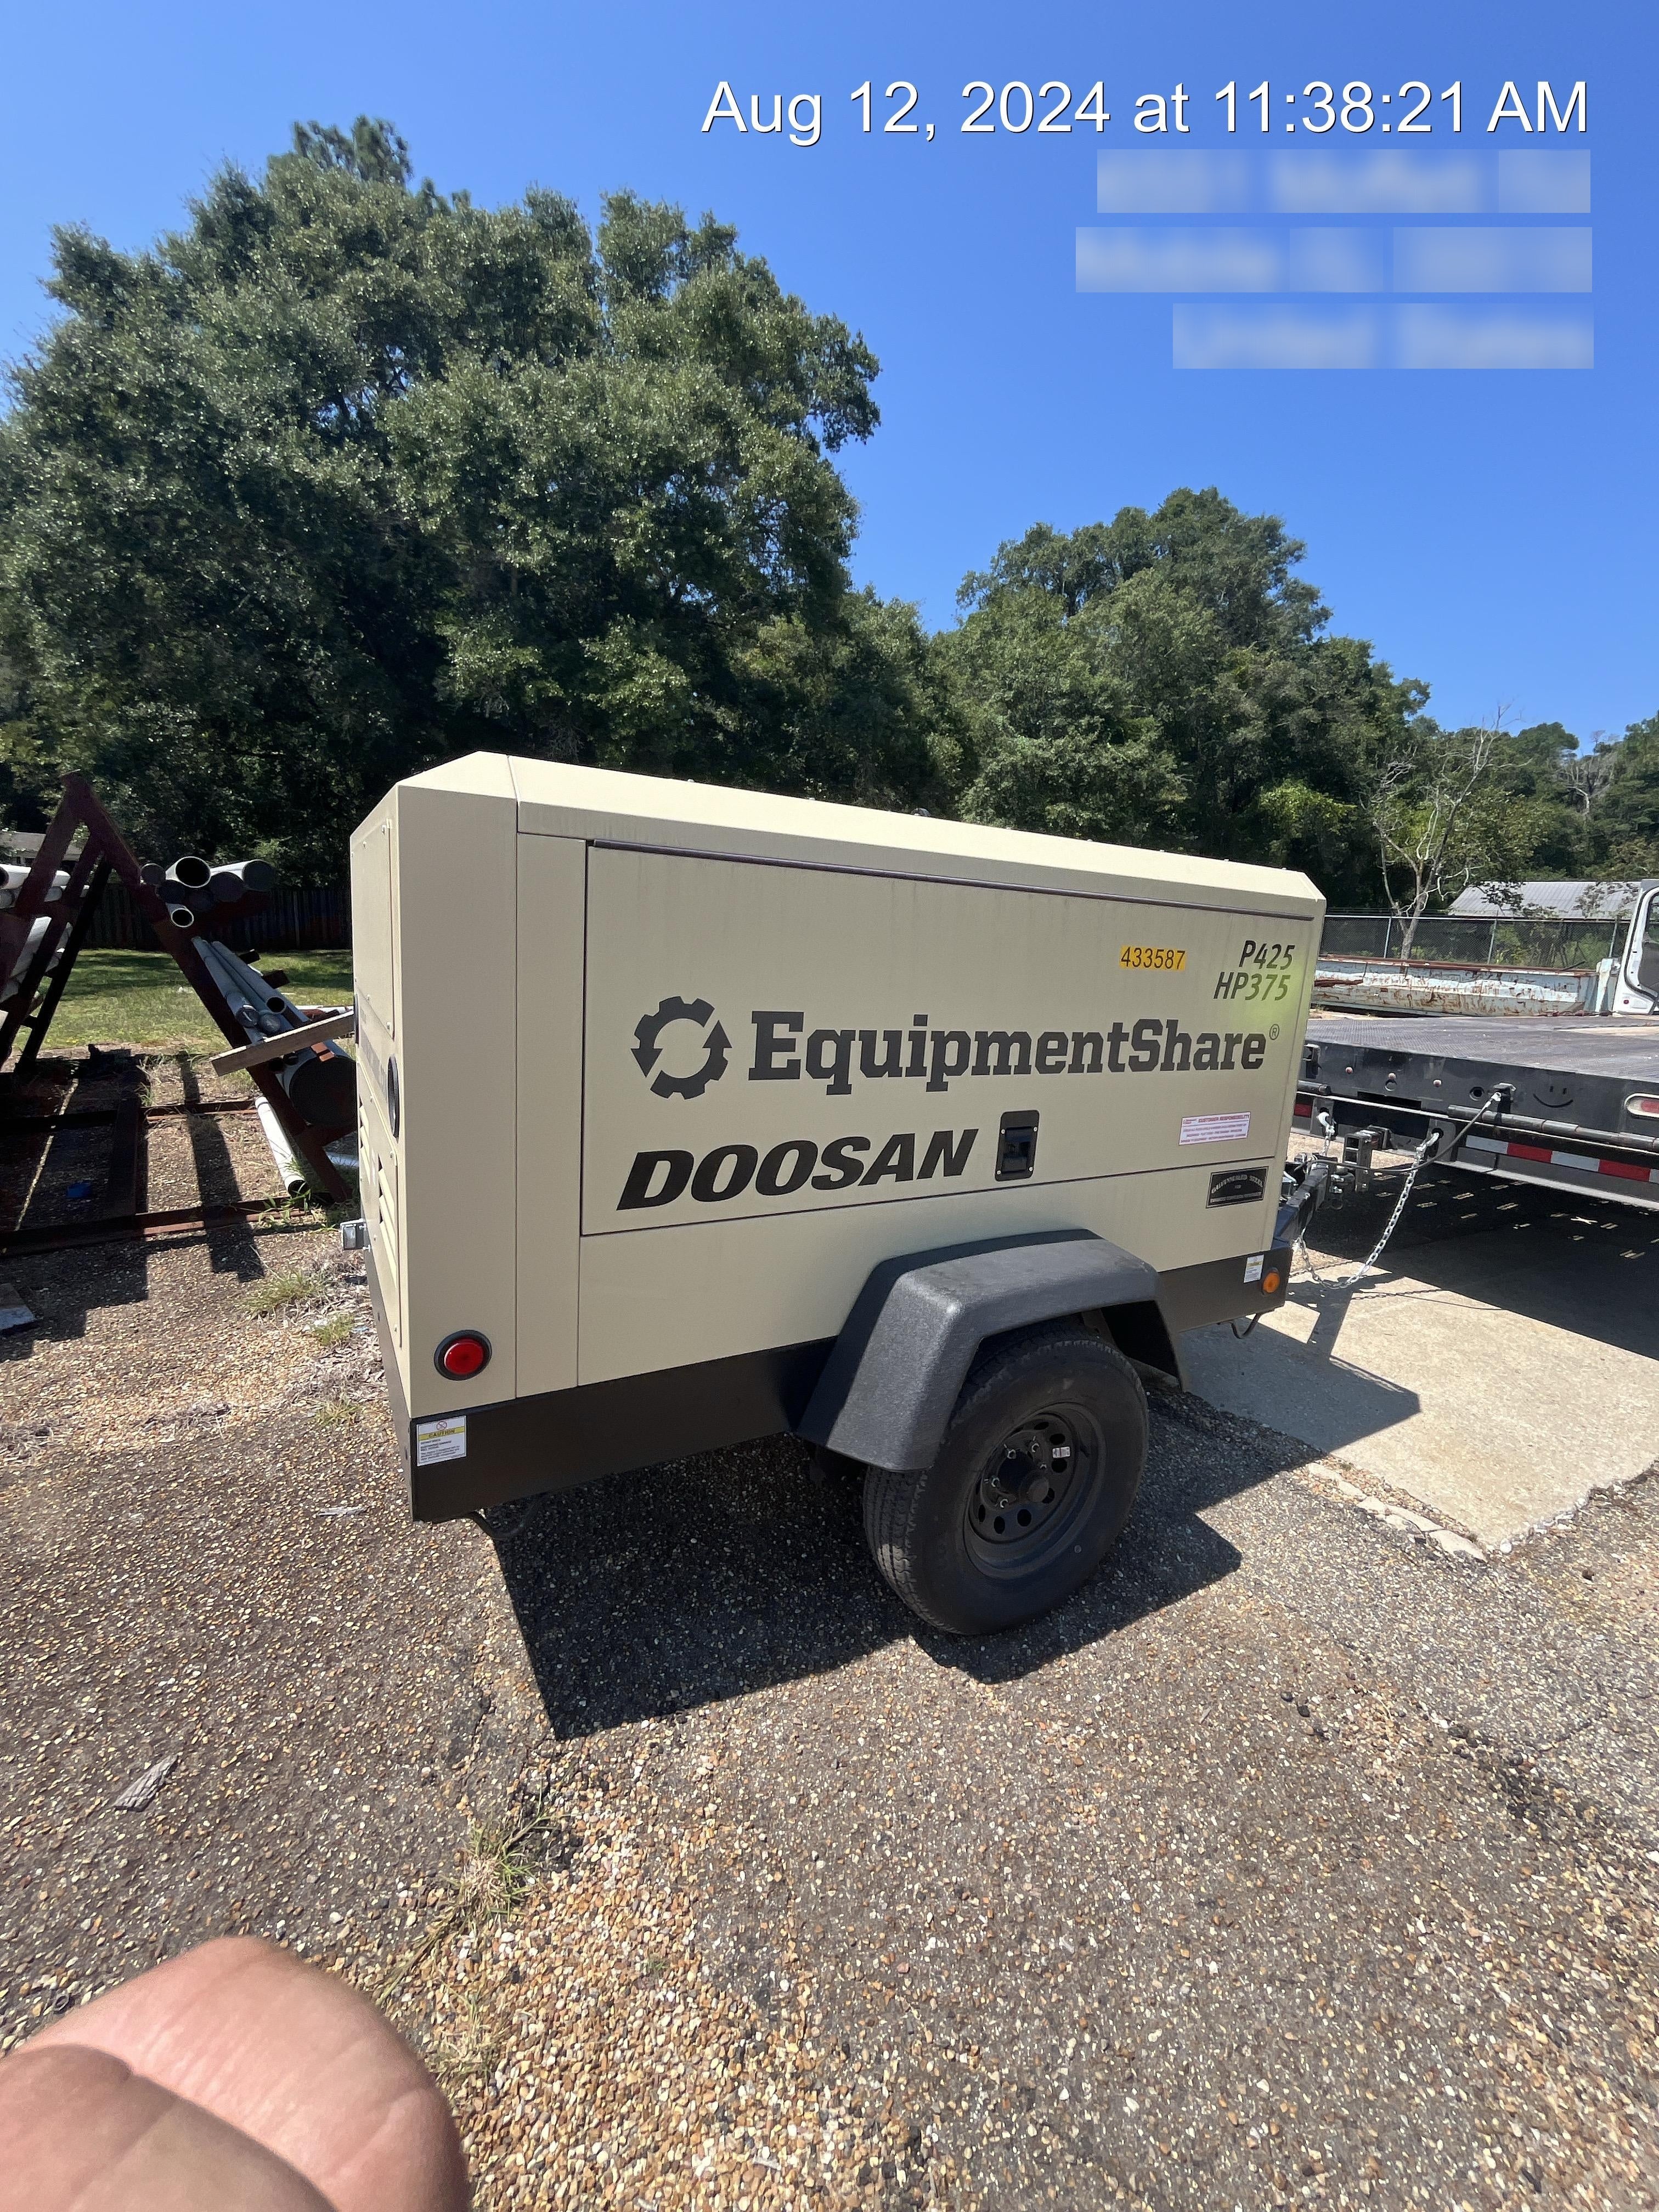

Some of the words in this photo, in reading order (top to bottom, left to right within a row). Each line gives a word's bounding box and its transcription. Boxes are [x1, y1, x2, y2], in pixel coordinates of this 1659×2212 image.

[1120, 946, 1186, 970] 433587
[1239, 940, 1295, 970] P425
[1213, 971, 1291, 1001] HP375
[616, 1128, 979, 1211] DOOSAN
[429, 1429, 455, 1437] CAUTION
